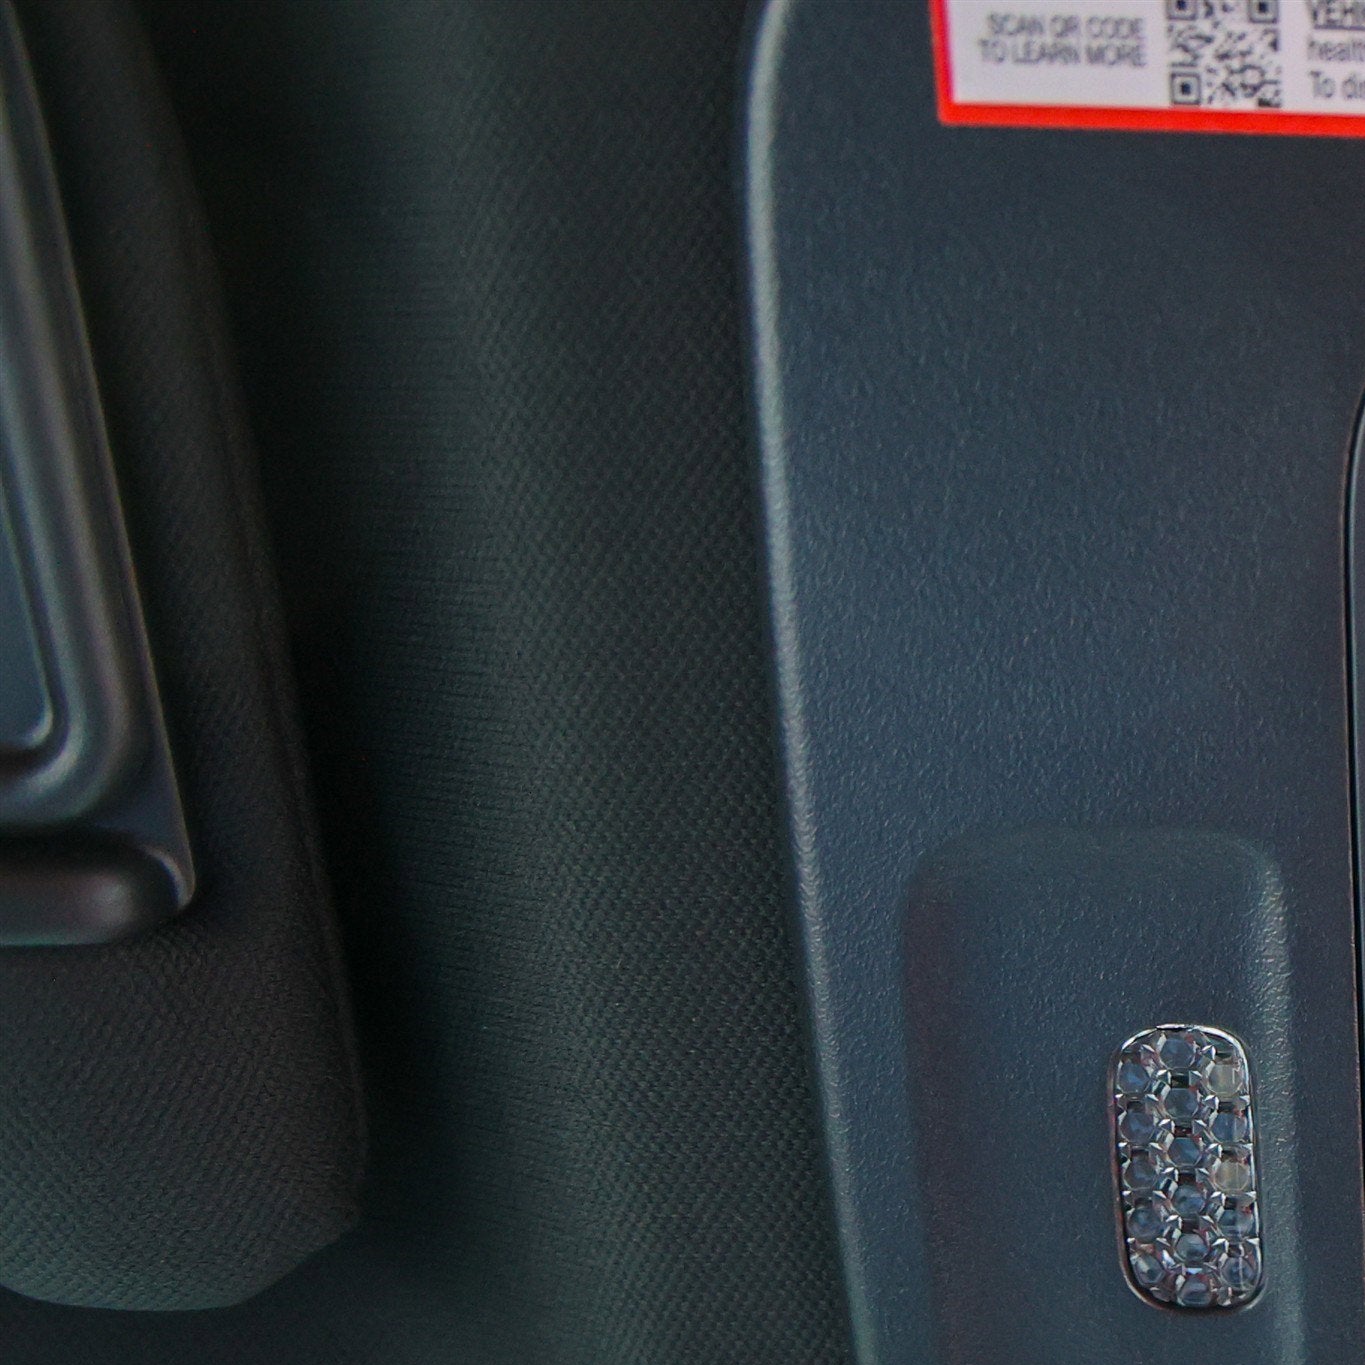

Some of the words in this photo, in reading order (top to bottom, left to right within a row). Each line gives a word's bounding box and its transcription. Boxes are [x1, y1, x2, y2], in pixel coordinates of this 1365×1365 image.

[987, 12, 1044, 36] SCAN
[1086, 15, 1145, 39] CODE
[978, 38, 1007, 63] TO
[1012, 40, 1080, 65] LEARN
[1086, 44, 1147, 68] MORE
[1309, 70, 1335, 98] To
